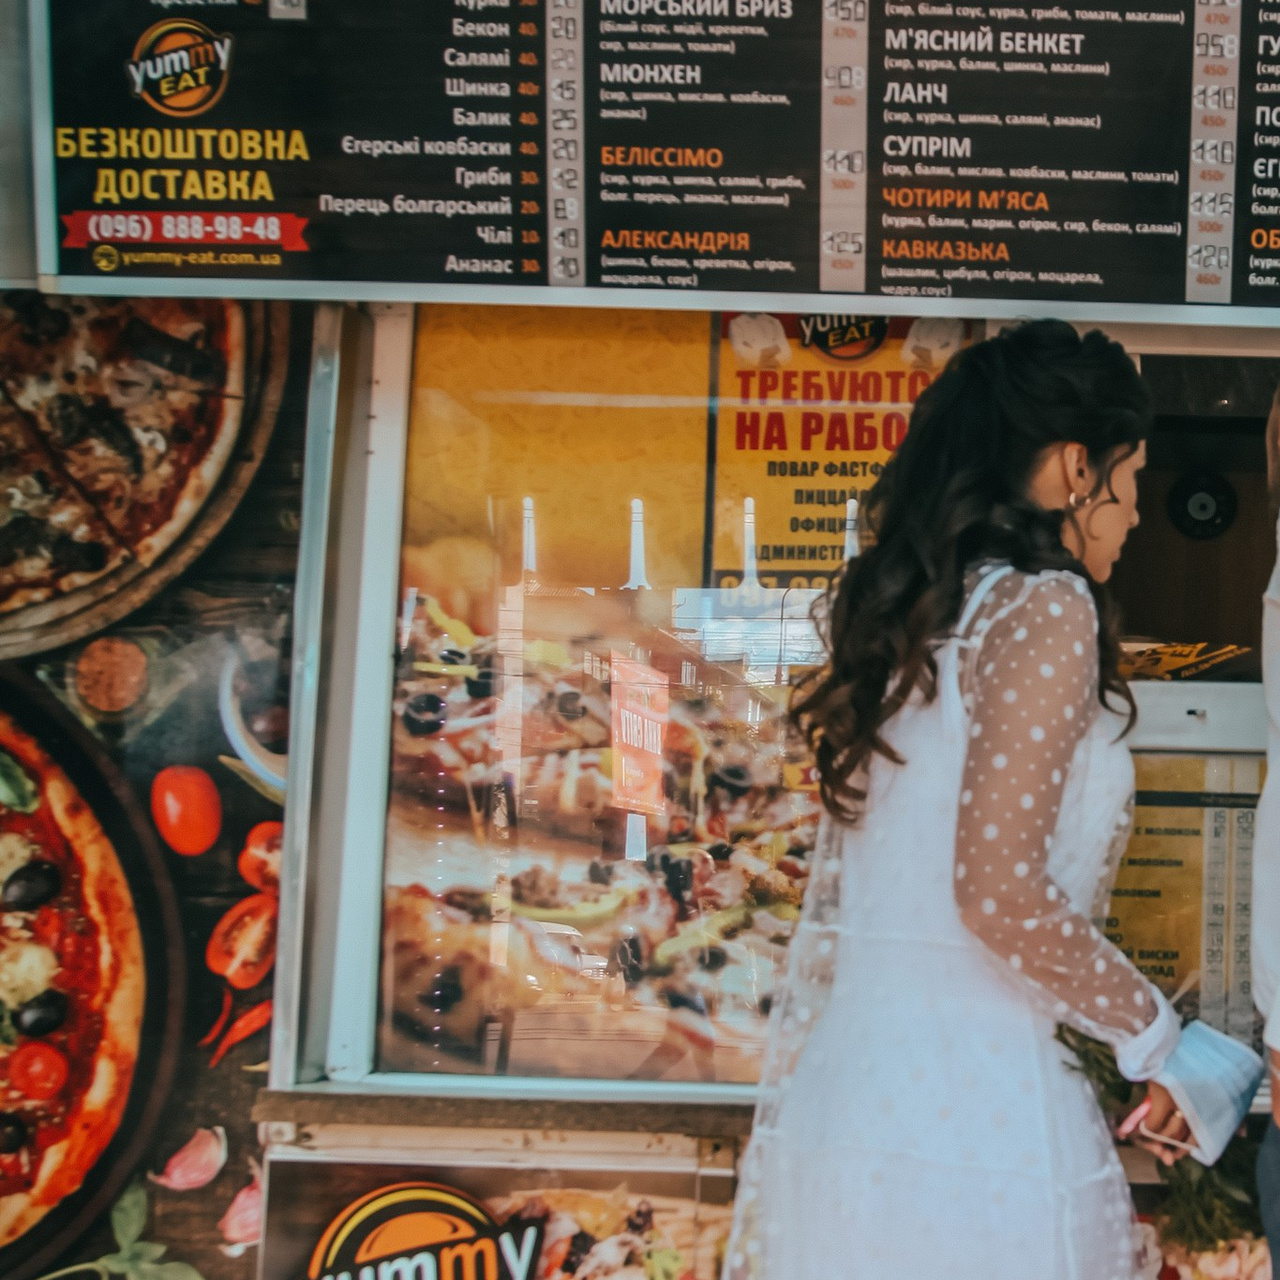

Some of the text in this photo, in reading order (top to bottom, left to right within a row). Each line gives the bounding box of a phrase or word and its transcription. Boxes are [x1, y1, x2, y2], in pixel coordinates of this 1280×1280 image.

[452, 18, 510, 36] Бекон
[885, 26, 993, 52] М'ЯСНИЙ
[1000, 31, 1085, 55] БЕНКЕТ
[129, 38, 231, 94] yummy
[444, 48, 510, 67] Салямі
[160, 67, 209, 96] EAT
[600, 63, 701, 84] МЮНХЕН
[445, 78, 510, 97] Шинка
[883, 83, 947, 105] ЛАНЧ
[453, 108, 511, 126] Балик
[55, 128, 310, 161] БЕЗКОШТОВНА
[424, 137, 511, 156] ковбаски
[883, 136, 972, 158] СУПРІМ
[601, 146, 723, 168] БЕЛІССІМО
[93, 169, 274, 204] ДОСТАВКА
[456, 167, 512, 188] Гриби
[319, 194, 512, 217] Перець болгарський
[882, 187, 972, 209] ЧОТИРИ
[89, 215, 281, 241] (096) 888-98-48
[476, 226, 512, 244] Чілі
[601, 230, 750, 253] АЛЕКСАНДРІЯ
[882, 239, 1010, 262] КАВКАЗЬКА
[445, 255, 513, 273] Ананас
[736, 370, 942, 405] ТРЕБУЮТС
[735, 411, 788, 450] НА
[768, 462, 819, 476] ПОВАР
